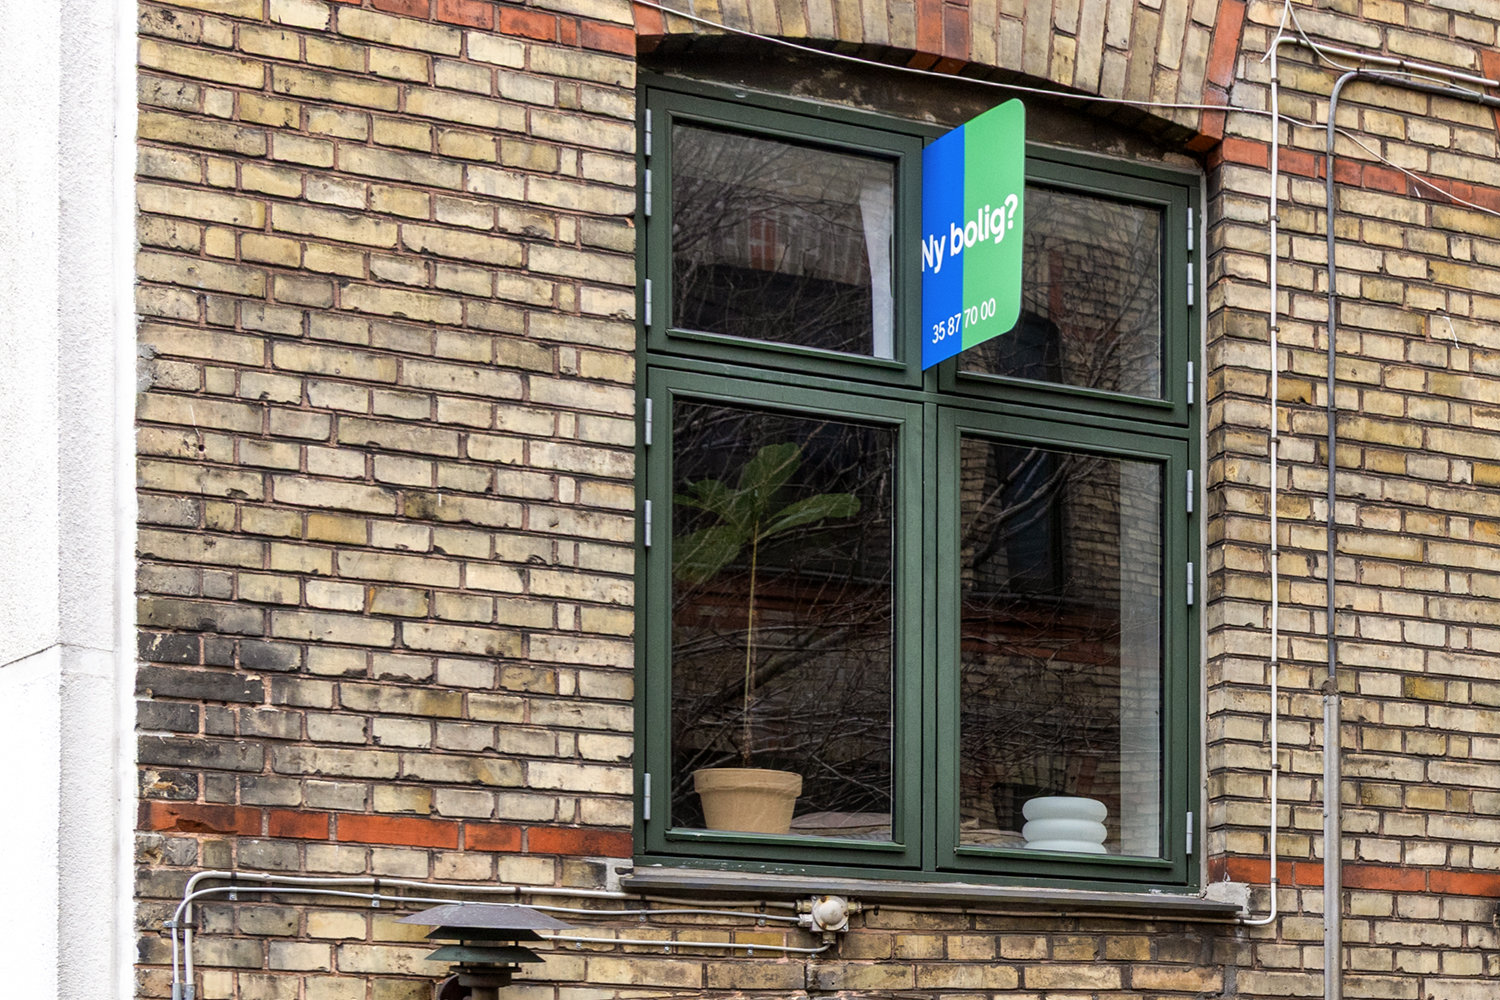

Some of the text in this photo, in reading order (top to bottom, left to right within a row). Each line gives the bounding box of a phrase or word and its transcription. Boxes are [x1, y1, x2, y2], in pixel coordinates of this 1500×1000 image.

[922, 193, 1018, 274] Ny bolig?
[932, 297, 996, 344] 35 87 70 00
